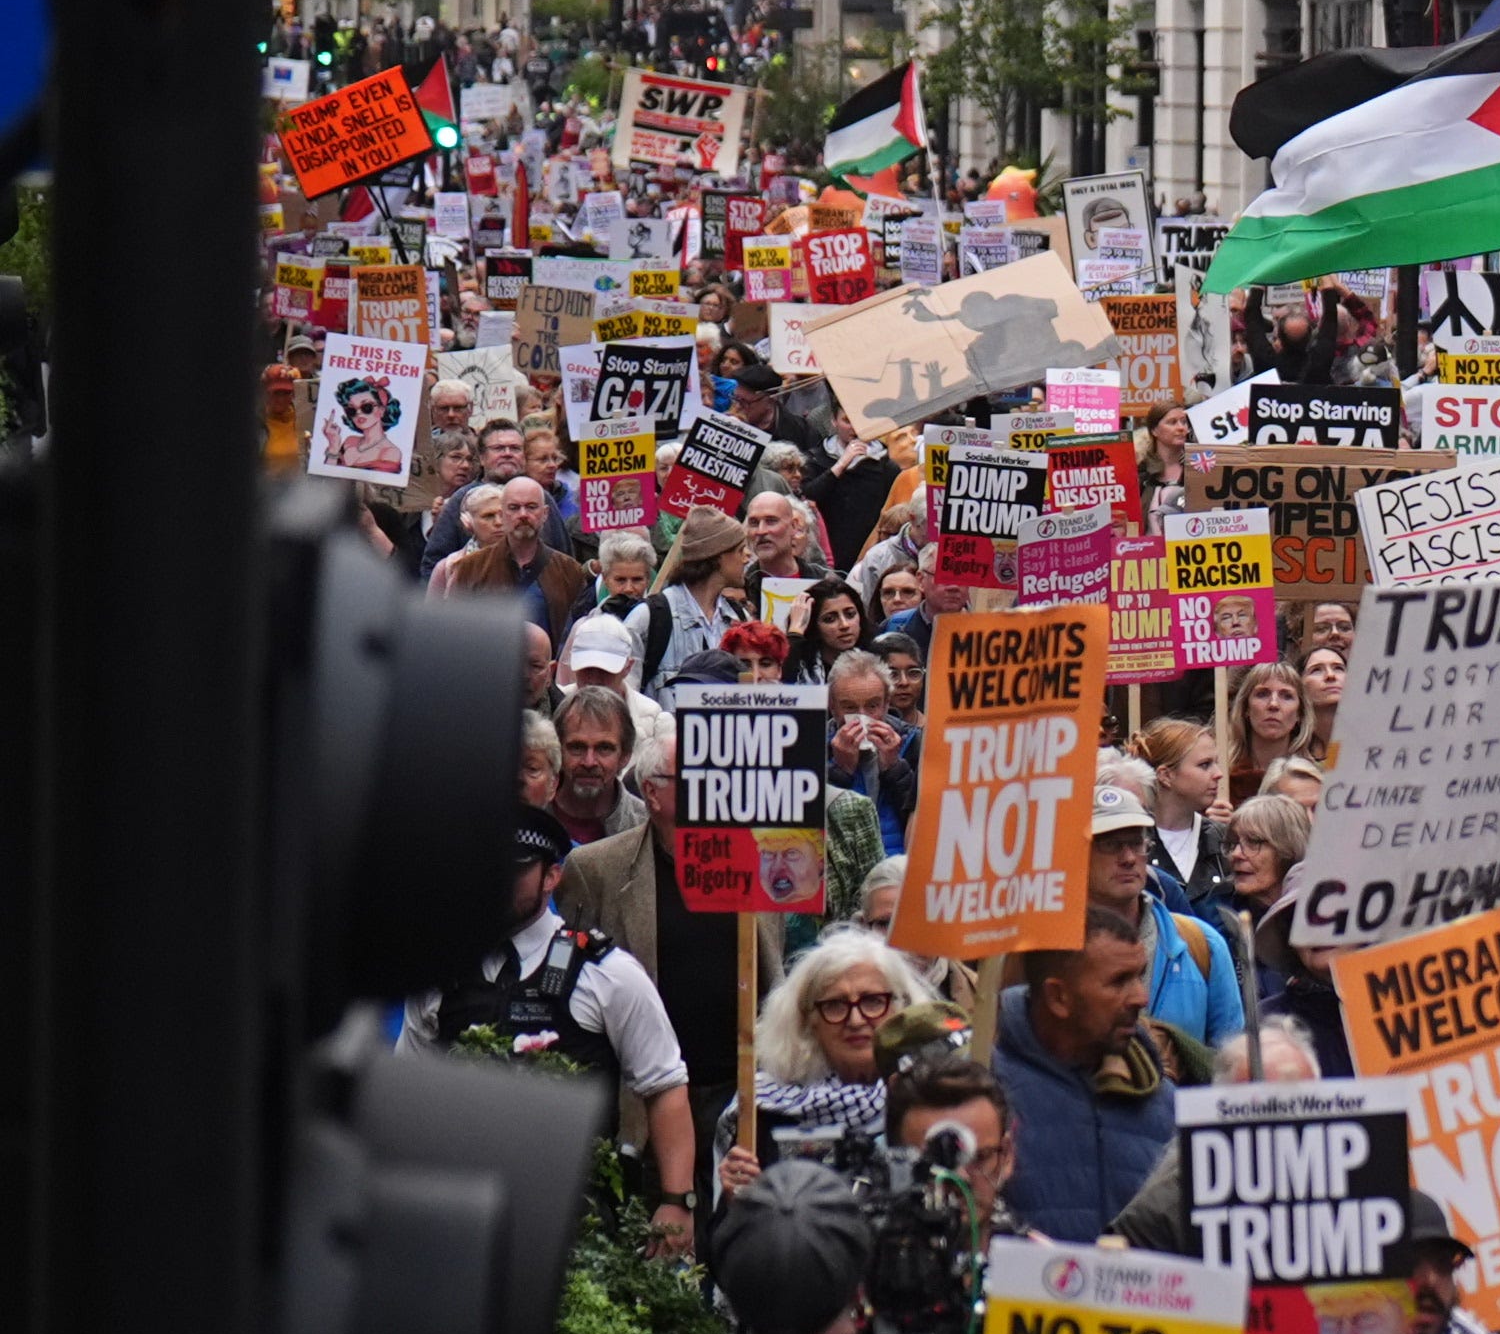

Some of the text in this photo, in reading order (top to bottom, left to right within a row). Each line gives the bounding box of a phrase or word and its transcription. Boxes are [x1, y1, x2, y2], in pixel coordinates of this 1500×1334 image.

[348, 79, 395, 108] EVEN
[290, 96, 411, 156] LYNDA SNELL IS
[295, 120, 405, 173] DISAPPOINTED
[341, 144, 400, 178] IN YOU!
[808, 234, 862, 261] STOP
[811, 255, 866, 276] TRUMP
[521, 286, 595, 317] FEED HIM
[536, 330, 560, 343] THE
[543, 313, 559, 331] TO
[329, 355, 419, 378] FREE SPEECH
[351, 345, 402, 362] THIS IS
[606, 354, 688, 377] Stop Starving
[597, 377, 682, 431] GAZA
[586, 441, 633, 459] NO TO
[696, 423, 754, 461] FREEDOM
[586, 455, 646, 475] RACISM
[680, 448, 747, 486] PALESTINE
[949, 622, 1086, 670] MIGRANTS
[947, 662, 1085, 710] WELCOME
[1390, 701, 1485, 734] LIAR
[682, 714, 799, 769] DUMP
[944, 717, 1079, 784] TRUMP
[1365, 738, 1500, 771] RACIST
[682, 767, 819, 824] TRUMP
[1324, 776, 1435, 813] CLIMATE
[683, 831, 730, 862] Fight
[932, 777, 1073, 881] NOT
[1361, 810, 1500, 850] DENIER
[683, 860, 753, 895] Bigotry
[925, 870, 1066, 924] WELCOME
[1307, 878, 1400, 933] GO
